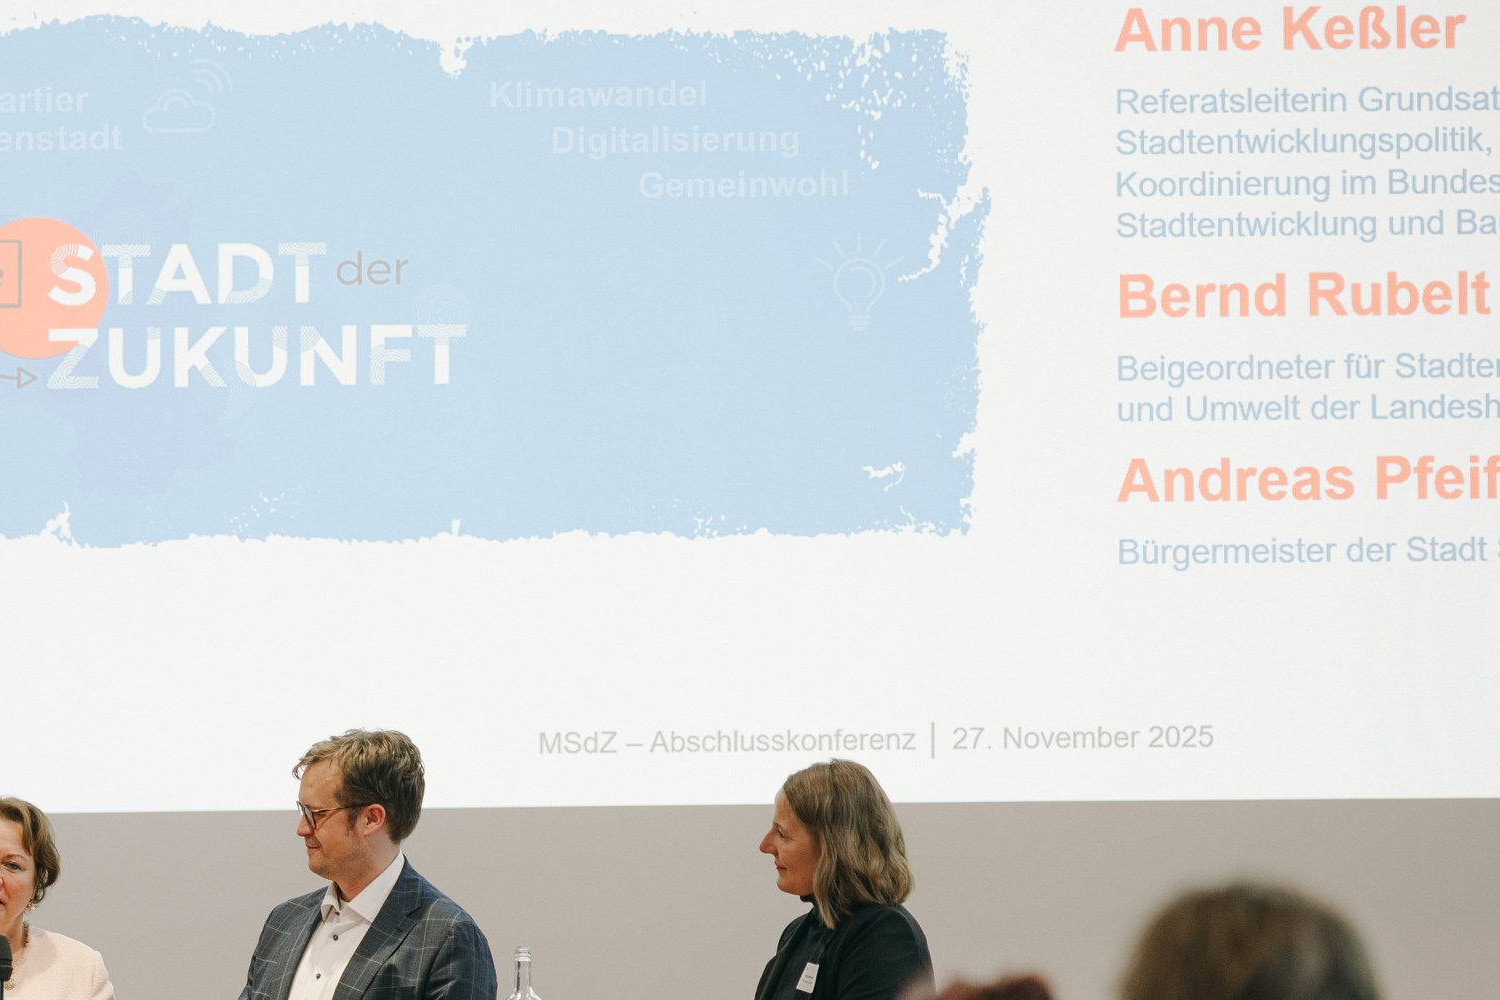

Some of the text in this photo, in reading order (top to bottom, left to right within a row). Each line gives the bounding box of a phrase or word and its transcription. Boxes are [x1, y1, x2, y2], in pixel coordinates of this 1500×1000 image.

[1114, 5, 1467, 52] Anne Keßler
[490, 81, 706, 108] Klimawandel
[1116, 86, 1348, 114] Referatsleiterin
[552, 126, 799, 160] Digitalisierung
[1116, 126, 1493, 160] Stadtentwicklungspolitik,
[639, 170, 849, 198] Gemeinwohl
[1116, 170, 1331, 203] Koordinierung
[1342, 169, 1377, 195] im
[1116, 208, 1500, 243] Stadtentwicklung und Ba
[48, 242, 327, 305] STADT
[336, 250, 410, 286] der
[1119, 270, 1492, 319] Bernd Rubelt
[47, 324, 467, 389] ZUKUNFT
[1116, 352, 1500, 388] Beigeordneter für Stadte
[1117, 393, 1500, 423] und Umwelt der Landesh
[1117, 454, 1500, 503] Andreas Pfeif
[1118, 537, 1338, 572] Bürgermeister
[1346, 537, 1397, 564] der
[1406, 536, 1489, 563] Stadt
[538, 731, 618, 755] MSdZ
[650, 728, 917, 753] Abschlusskonferenz
[952, 726, 991, 751] 27.
[1003, 725, 1141, 750] November
[1148, 725, 1215, 749] 2025
